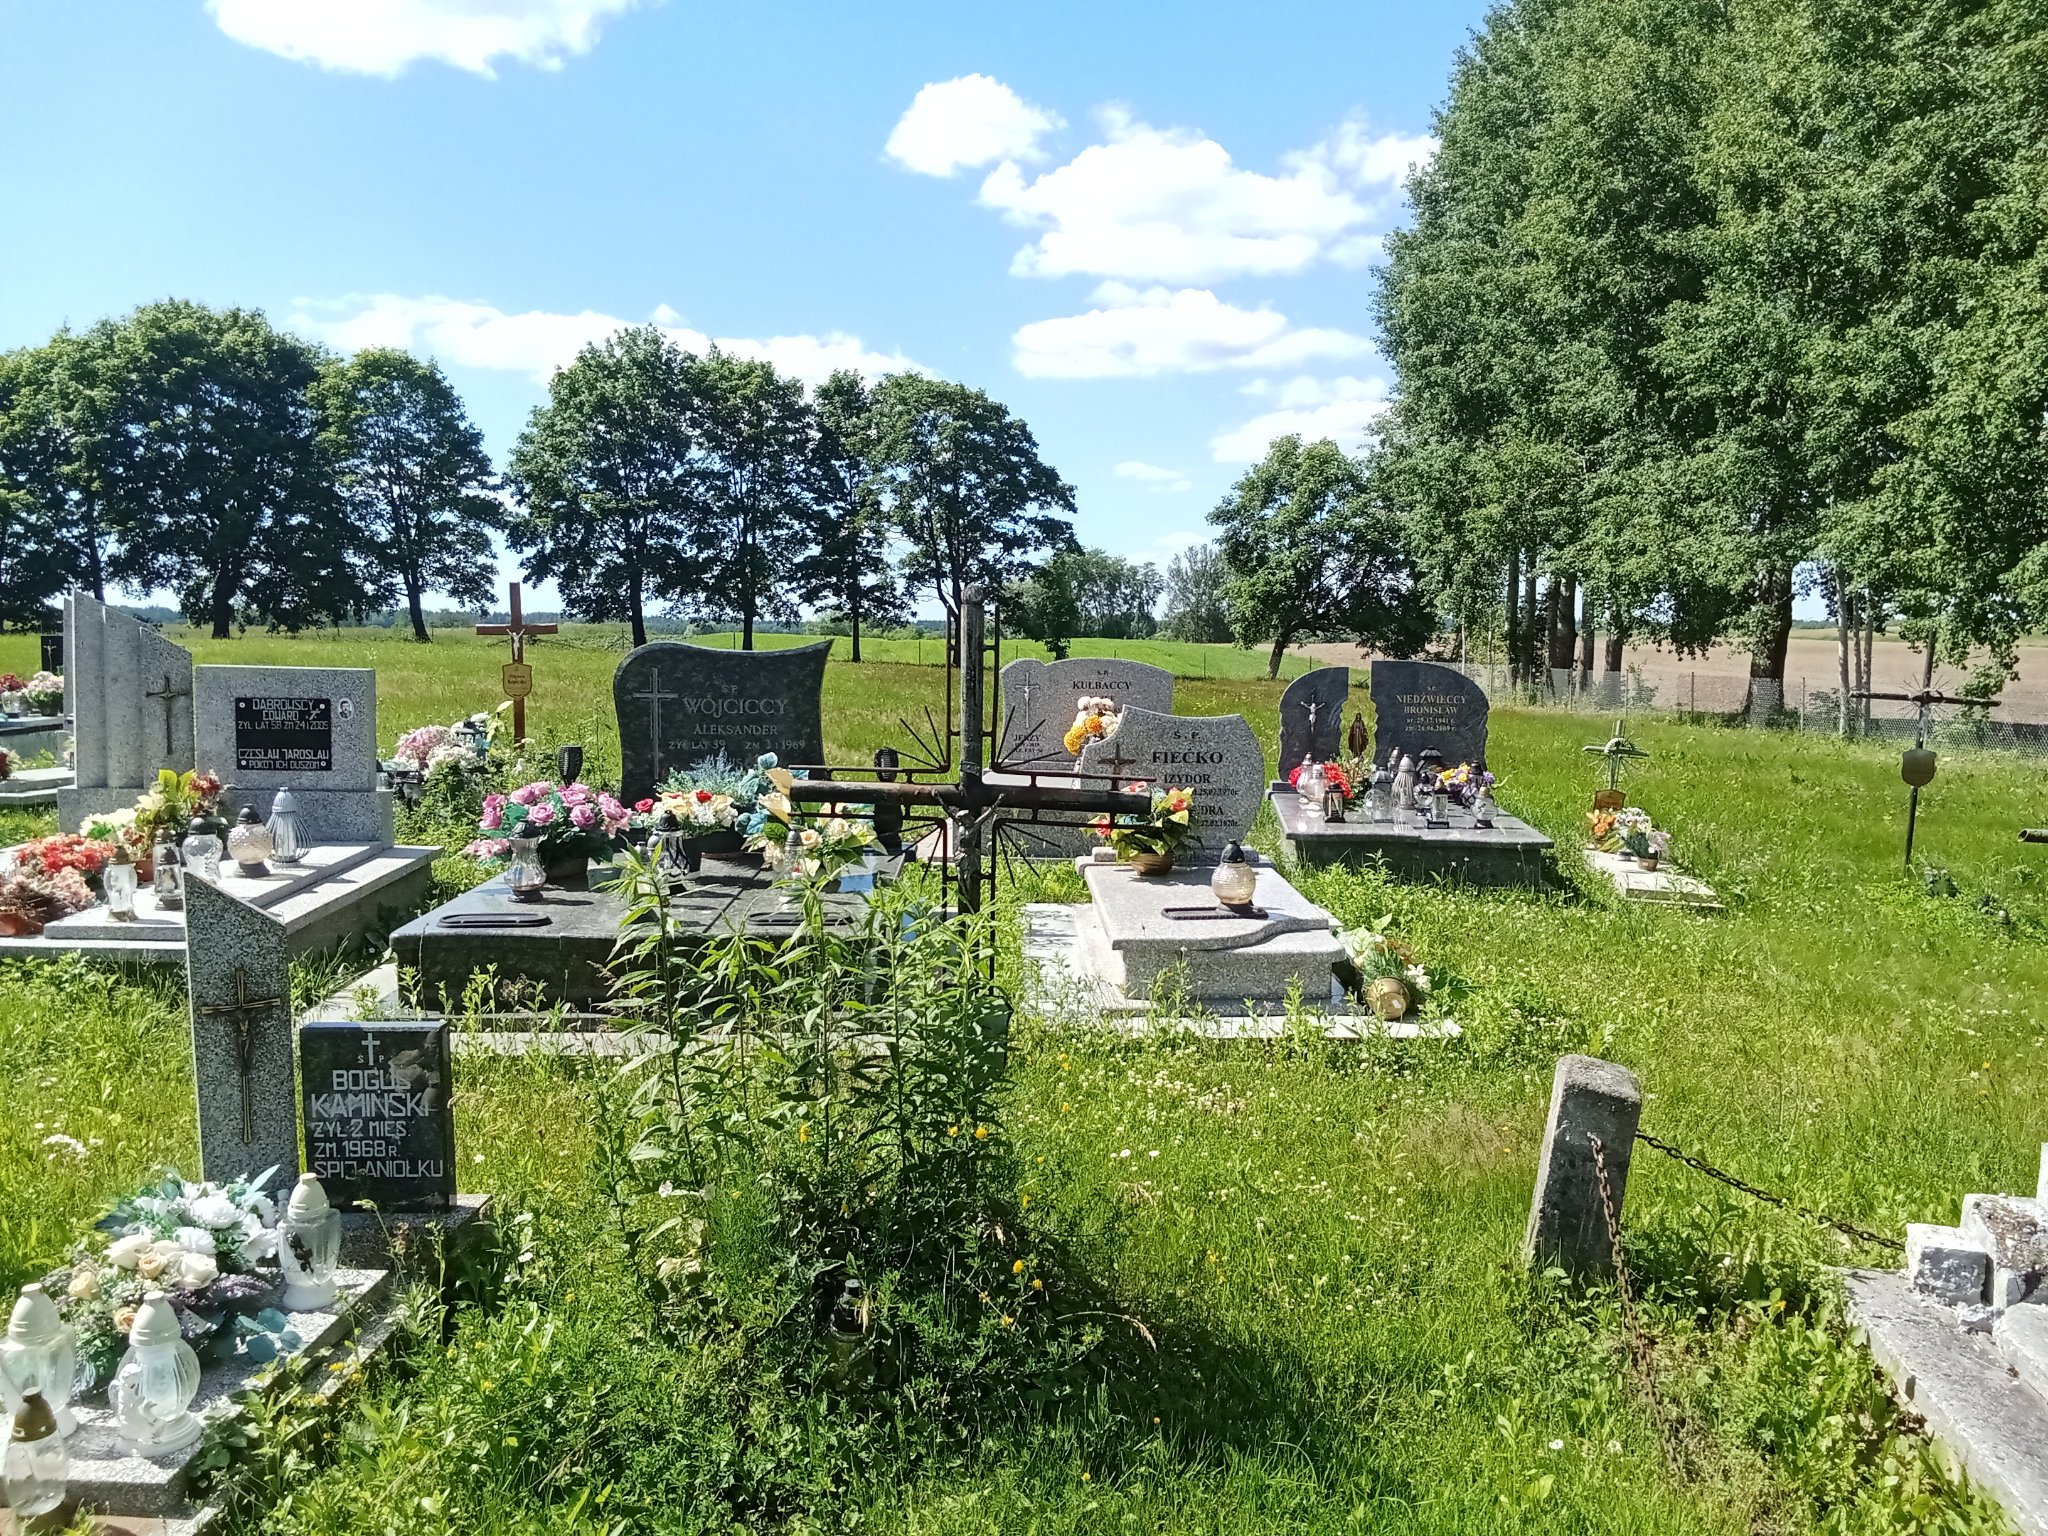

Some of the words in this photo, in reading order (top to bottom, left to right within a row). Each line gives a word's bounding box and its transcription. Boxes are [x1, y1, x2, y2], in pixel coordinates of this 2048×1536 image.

[1072, 680, 1131, 690] KULBACCY
[682, 694, 788, 718] WÓJCICCY
[693, 723, 778, 735] ALEKSANDER
[1164, 773, 1212, 784] IZYDOR
[341, 1139, 386, 1158] 1968
